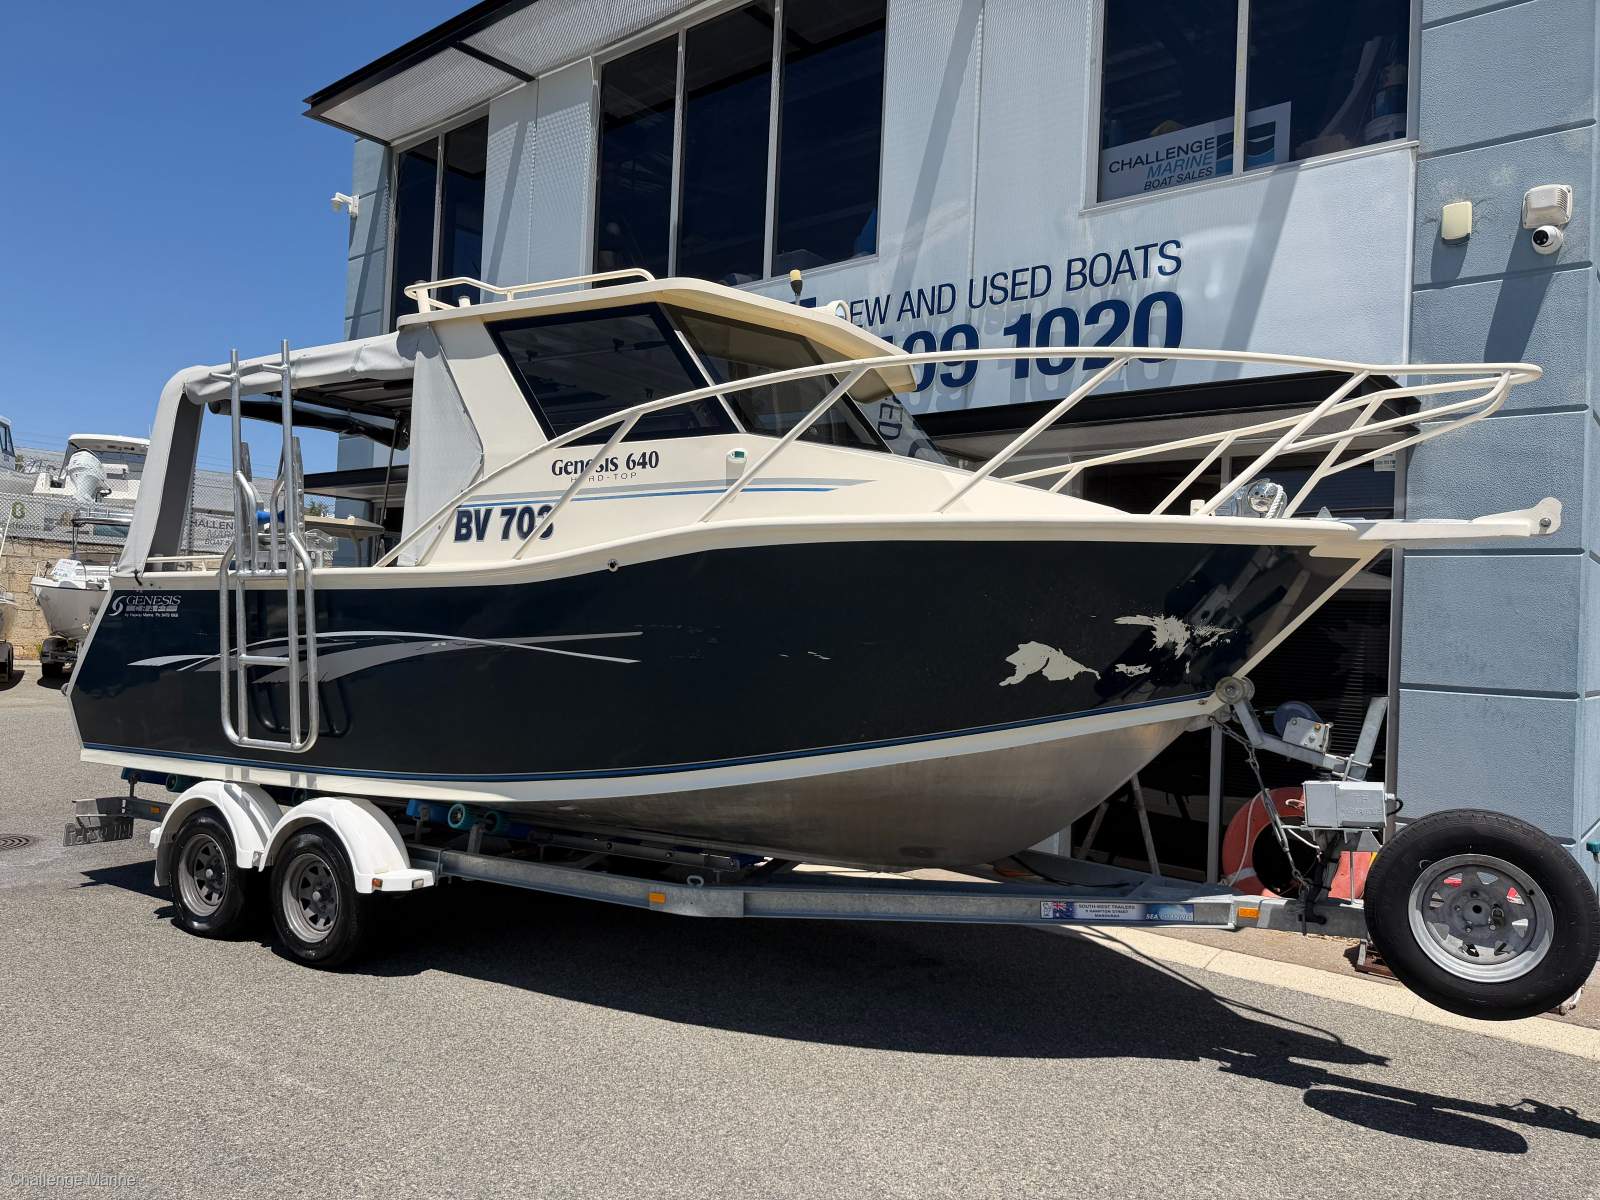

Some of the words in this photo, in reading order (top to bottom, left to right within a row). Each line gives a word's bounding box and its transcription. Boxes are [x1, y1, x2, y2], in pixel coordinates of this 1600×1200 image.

[1108, 136, 1215, 174] CHALLENGE
[1147, 150, 1214, 179] MARINE
[1143, 175, 1174, 191] BOAT
[1176, 166, 1213, 183] SALES
[849, 294, 891, 328] EW
[897, 283, 957, 322] AND
[968, 265, 1052, 309] USED
[1065, 239, 1182, 292] BOATS
[882, 323, 980, 393] 09
[1003, 290, 1184, 381] 1020
[625, 450, 660, 470] 640
[570, 471, 637, 483] HRD-TOP
[191, 519, 235, 531] HALLEN
[454, 506, 494, 542] BV
[126, 595, 181, 605] GENESIS
